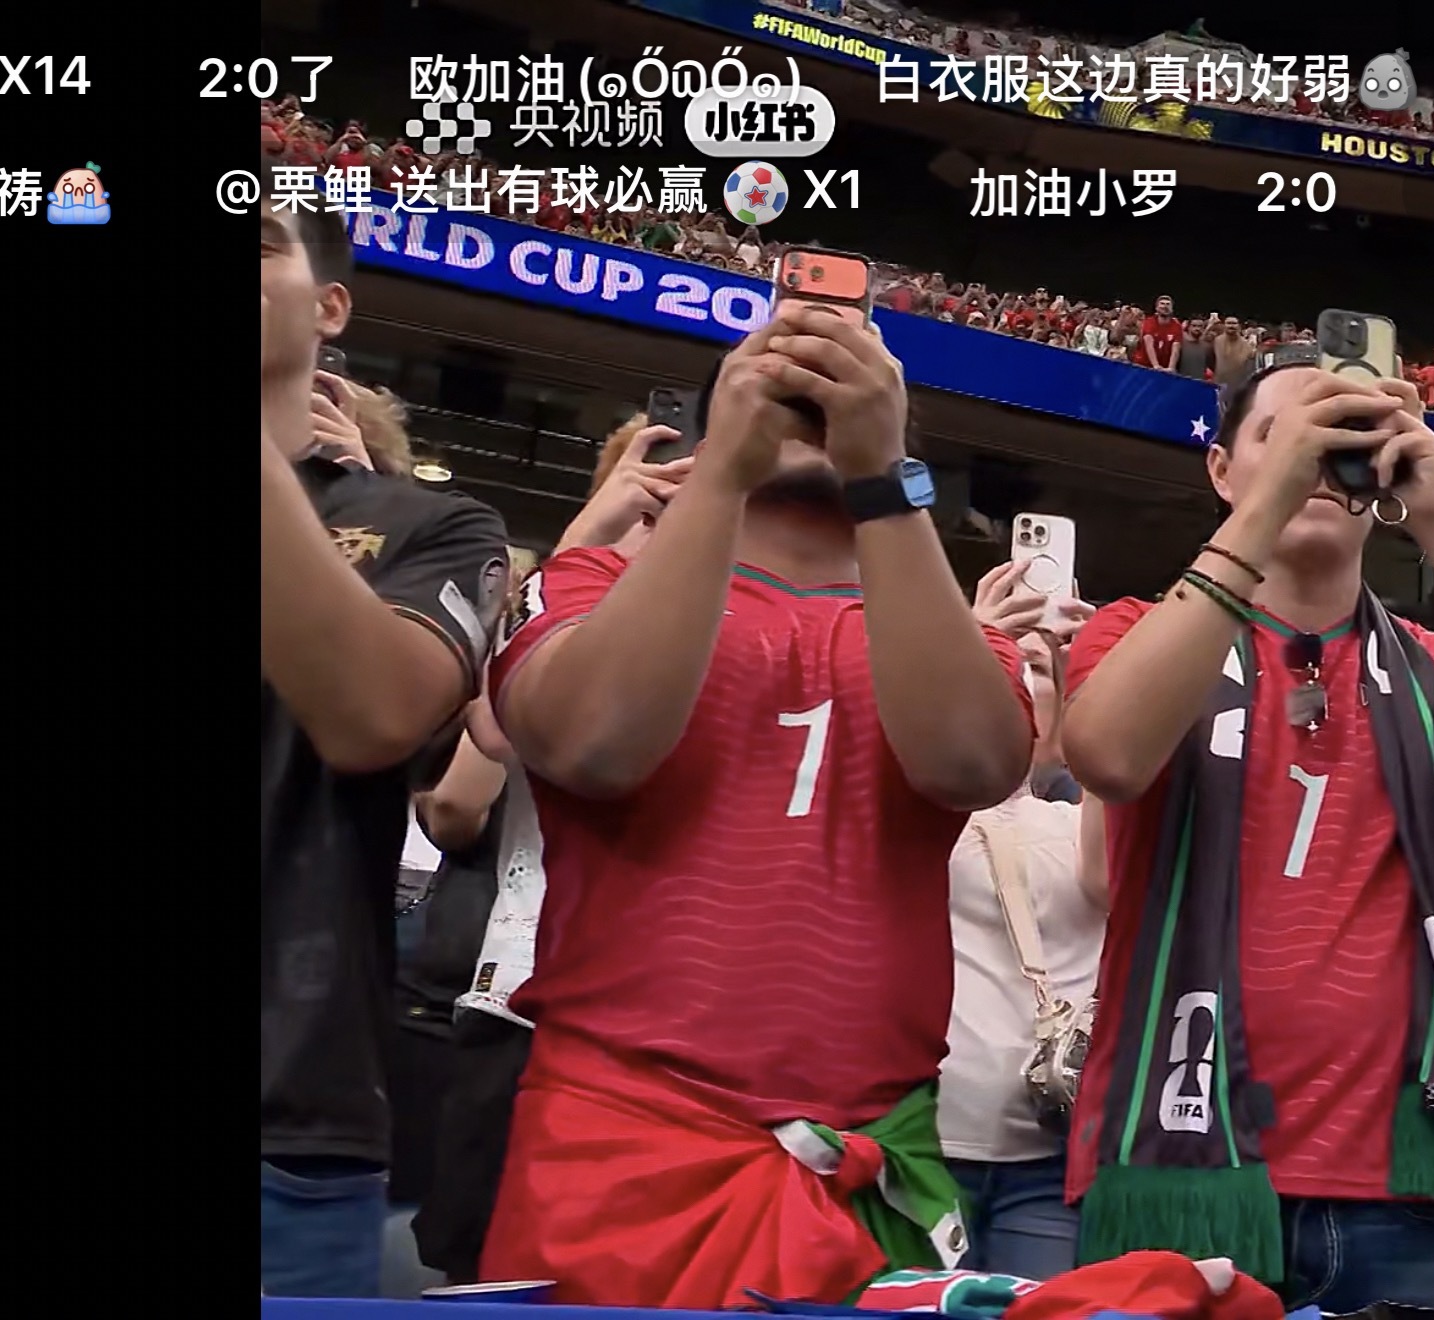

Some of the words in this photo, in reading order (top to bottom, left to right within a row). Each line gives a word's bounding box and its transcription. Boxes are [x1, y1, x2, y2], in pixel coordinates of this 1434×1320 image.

[752, 12, 887, 65] #FIFAWorldCup
[508, 239, 645, 302] CUP
[777, 698, 834, 818] 7
[1170, 1103, 1204, 1119] FIFA
